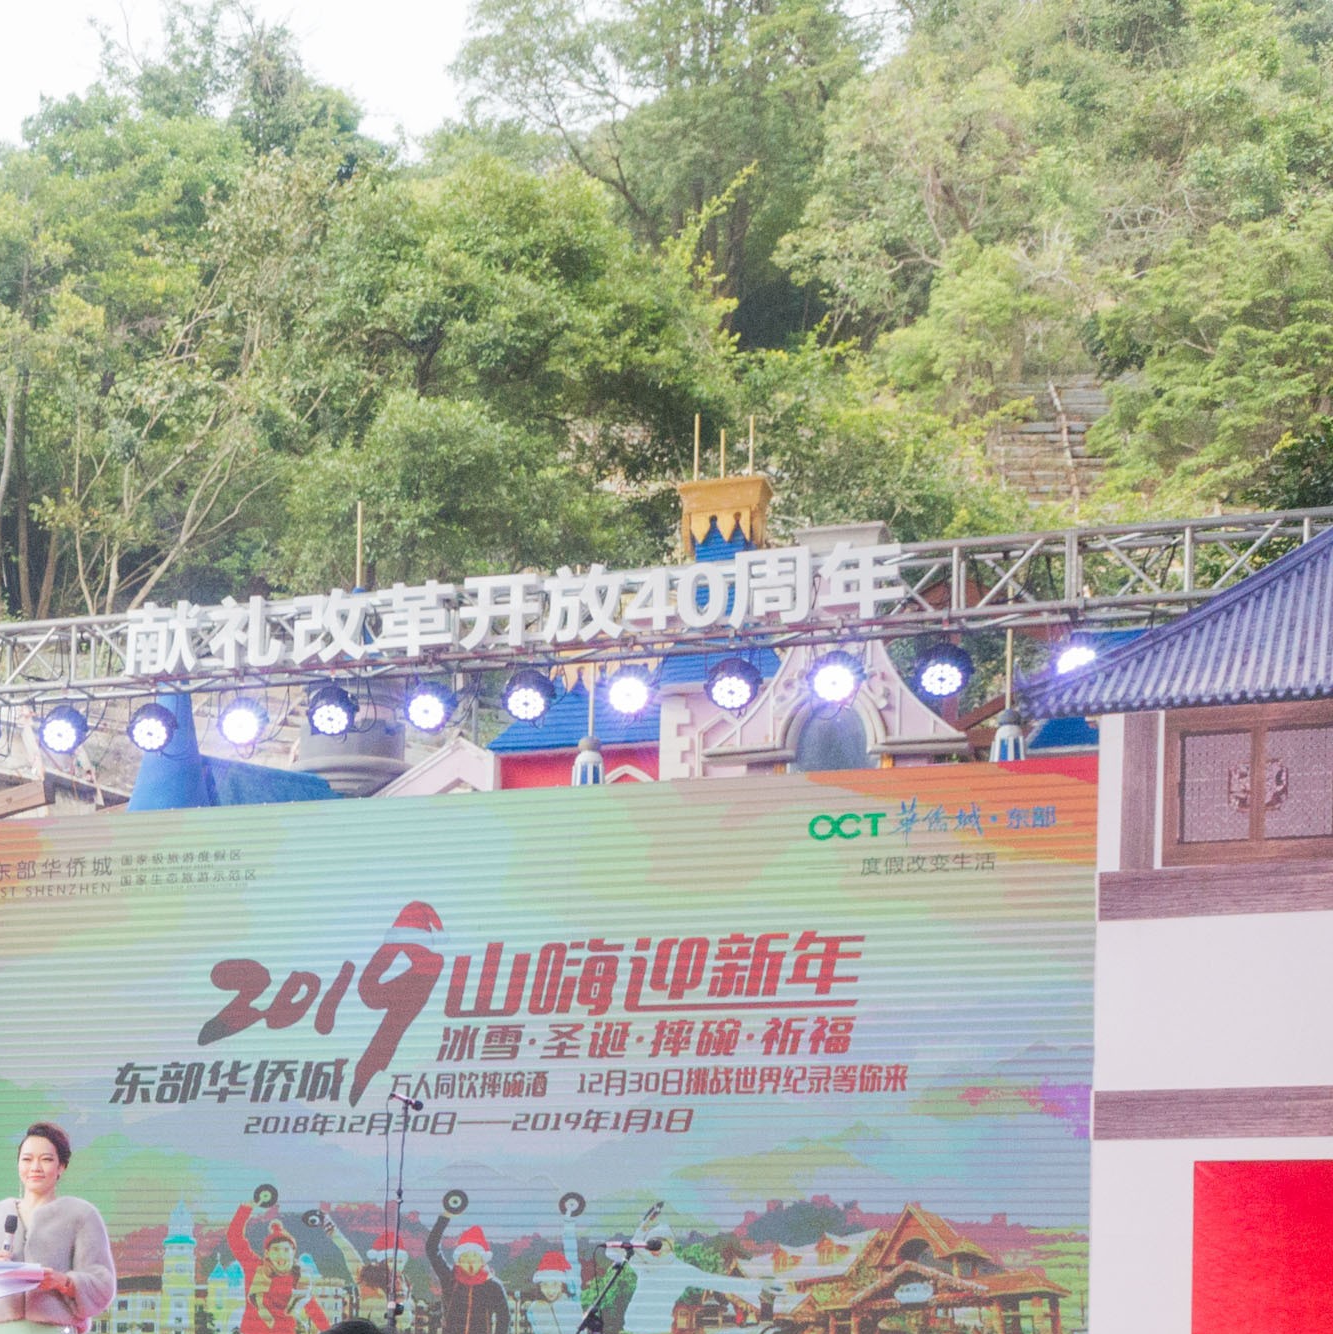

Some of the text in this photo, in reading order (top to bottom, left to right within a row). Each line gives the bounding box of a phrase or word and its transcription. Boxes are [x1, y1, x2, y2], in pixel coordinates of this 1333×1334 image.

[125, 540, 909, 676] 献礼改革开放40周年
[808, 812, 887, 841] OCT
[861, 852, 996, 876] 度假改变生活
[25, 882, 112, 898] SHENZHEN
[197, 930, 866, 1107] 2019 山嗨迎新年
[108, 1057, 350, 1105] 东部华侨城
[391, 1064, 909, 1101] 万人同饮摔碗酒 12月30日挑战世界纪录等你来
